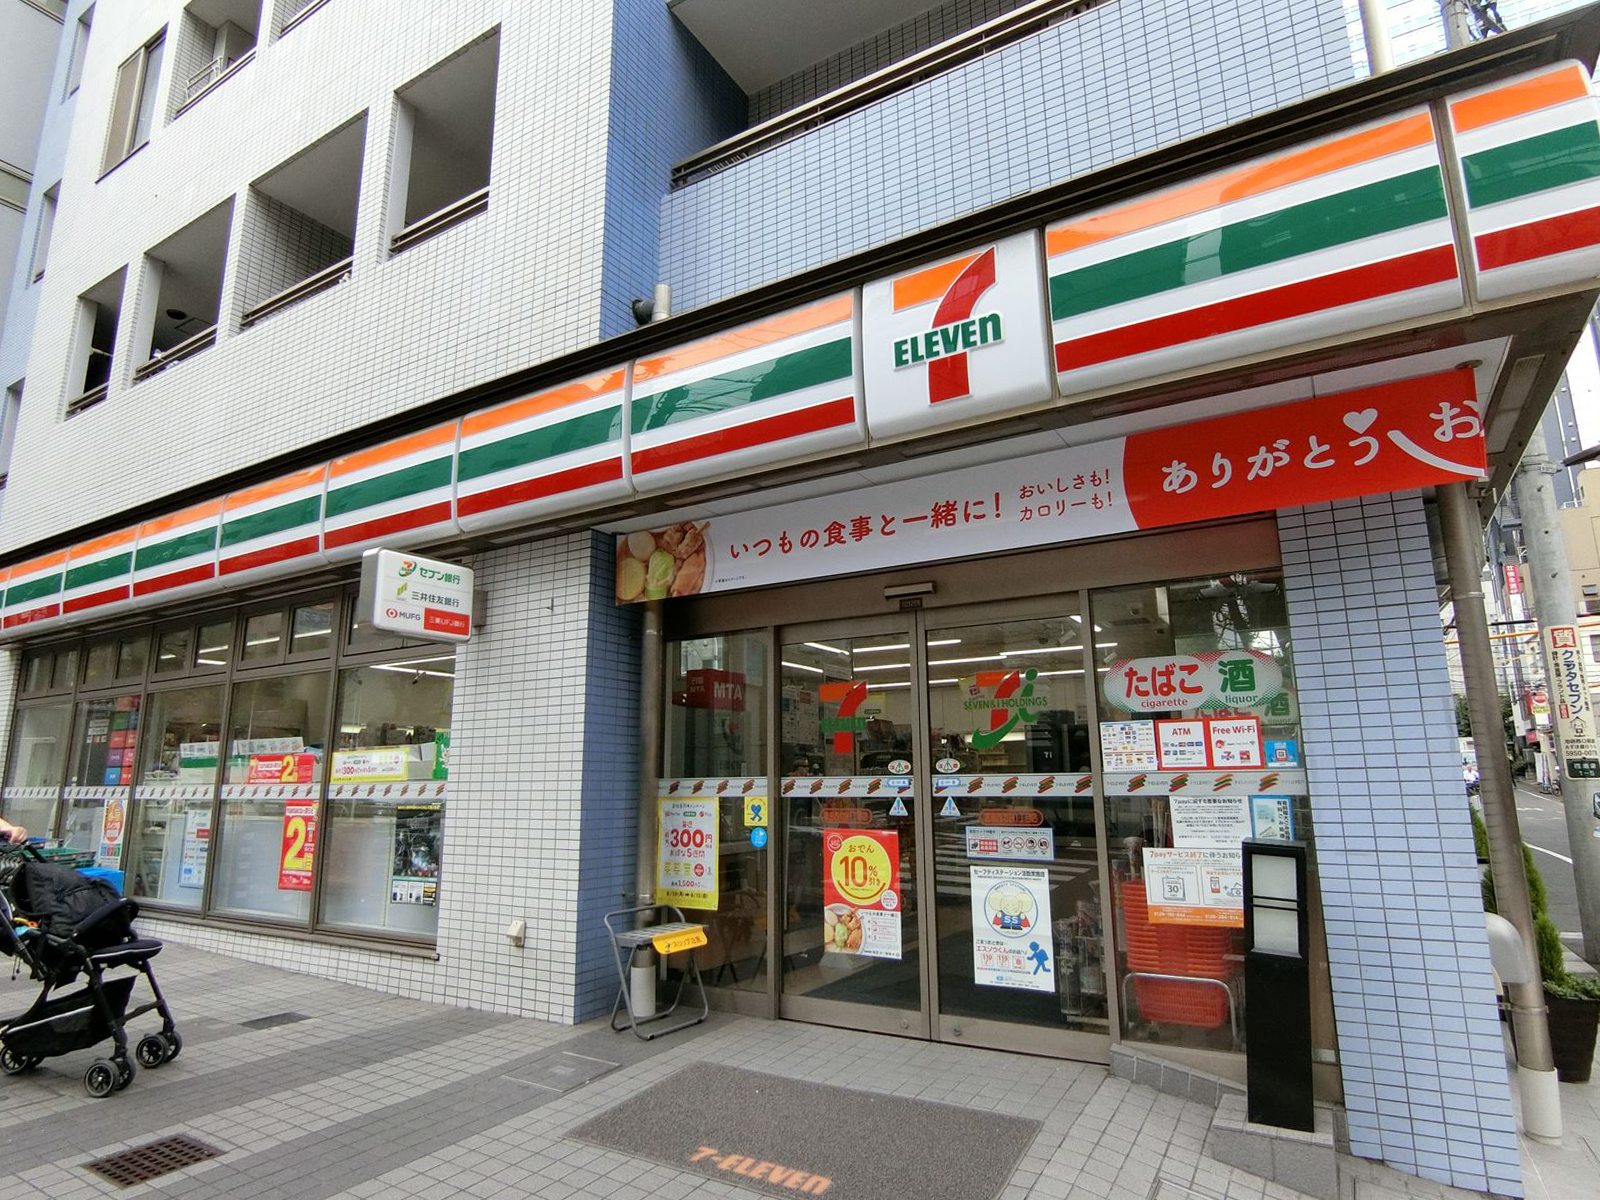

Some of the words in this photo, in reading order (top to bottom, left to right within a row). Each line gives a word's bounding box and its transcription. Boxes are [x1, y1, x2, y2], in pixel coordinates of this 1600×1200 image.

[1161, 412, 1380, 494] ありがとう
[1019, 468, 1110, 499] おいしさも!
[1019, 491, 1113, 522] カロリーも!
[729, 491, 1002, 559] いつもの食事と一緒に!
[419, 567, 461, 585] セブン銀行
[411, 590, 460, 608] 三井住友銀行
[399, 612, 421, 621] MUFG
[1124, 662, 1203, 699] たばこ
[1217, 658, 1256, 693] 酒
[1002, 696, 1047, 708] HOLDINGS
[1141, 697, 1188, 709] cigarette
[1225, 693, 1258, 705] liquor
[1172, 728, 1191, 736] ATM
[1212, 726, 1231, 735] Free
[1233, 725, 1256, 734] Wi-Fi
[848, 844, 875, 853] おでん
[1167, 884, 1179, 893] 30
[1003, 915, 1019, 924] SS
